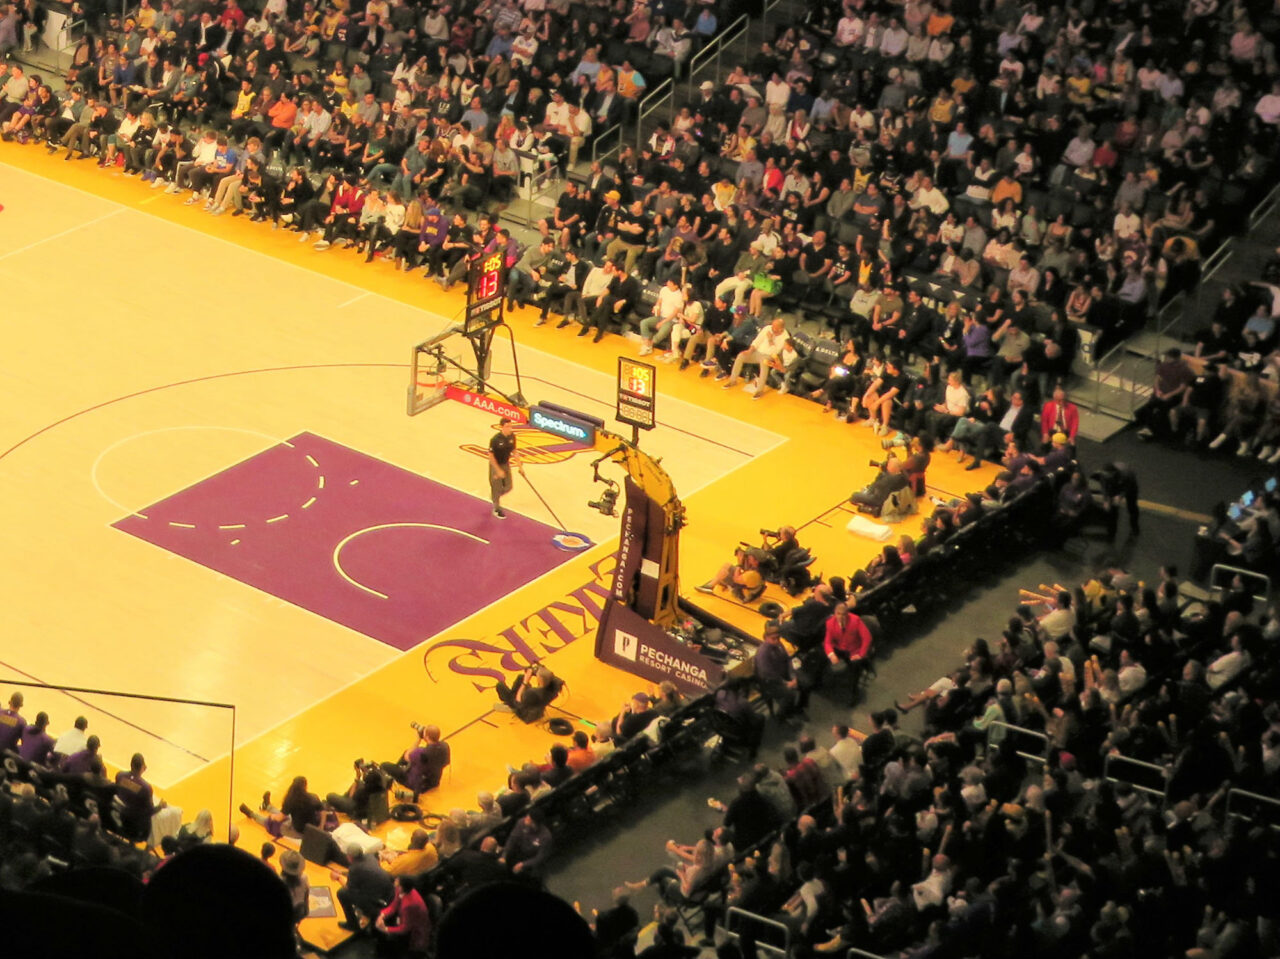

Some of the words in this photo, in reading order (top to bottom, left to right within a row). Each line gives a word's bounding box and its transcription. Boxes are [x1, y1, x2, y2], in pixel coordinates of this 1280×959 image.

[483, 271, 498, 297] 13
[473, 395, 521, 421] AAA.com
[533, 412, 585, 439] Spectrum
[639, 643, 709, 682] PECHANGA
[639, 654, 672, 674] RESORT
